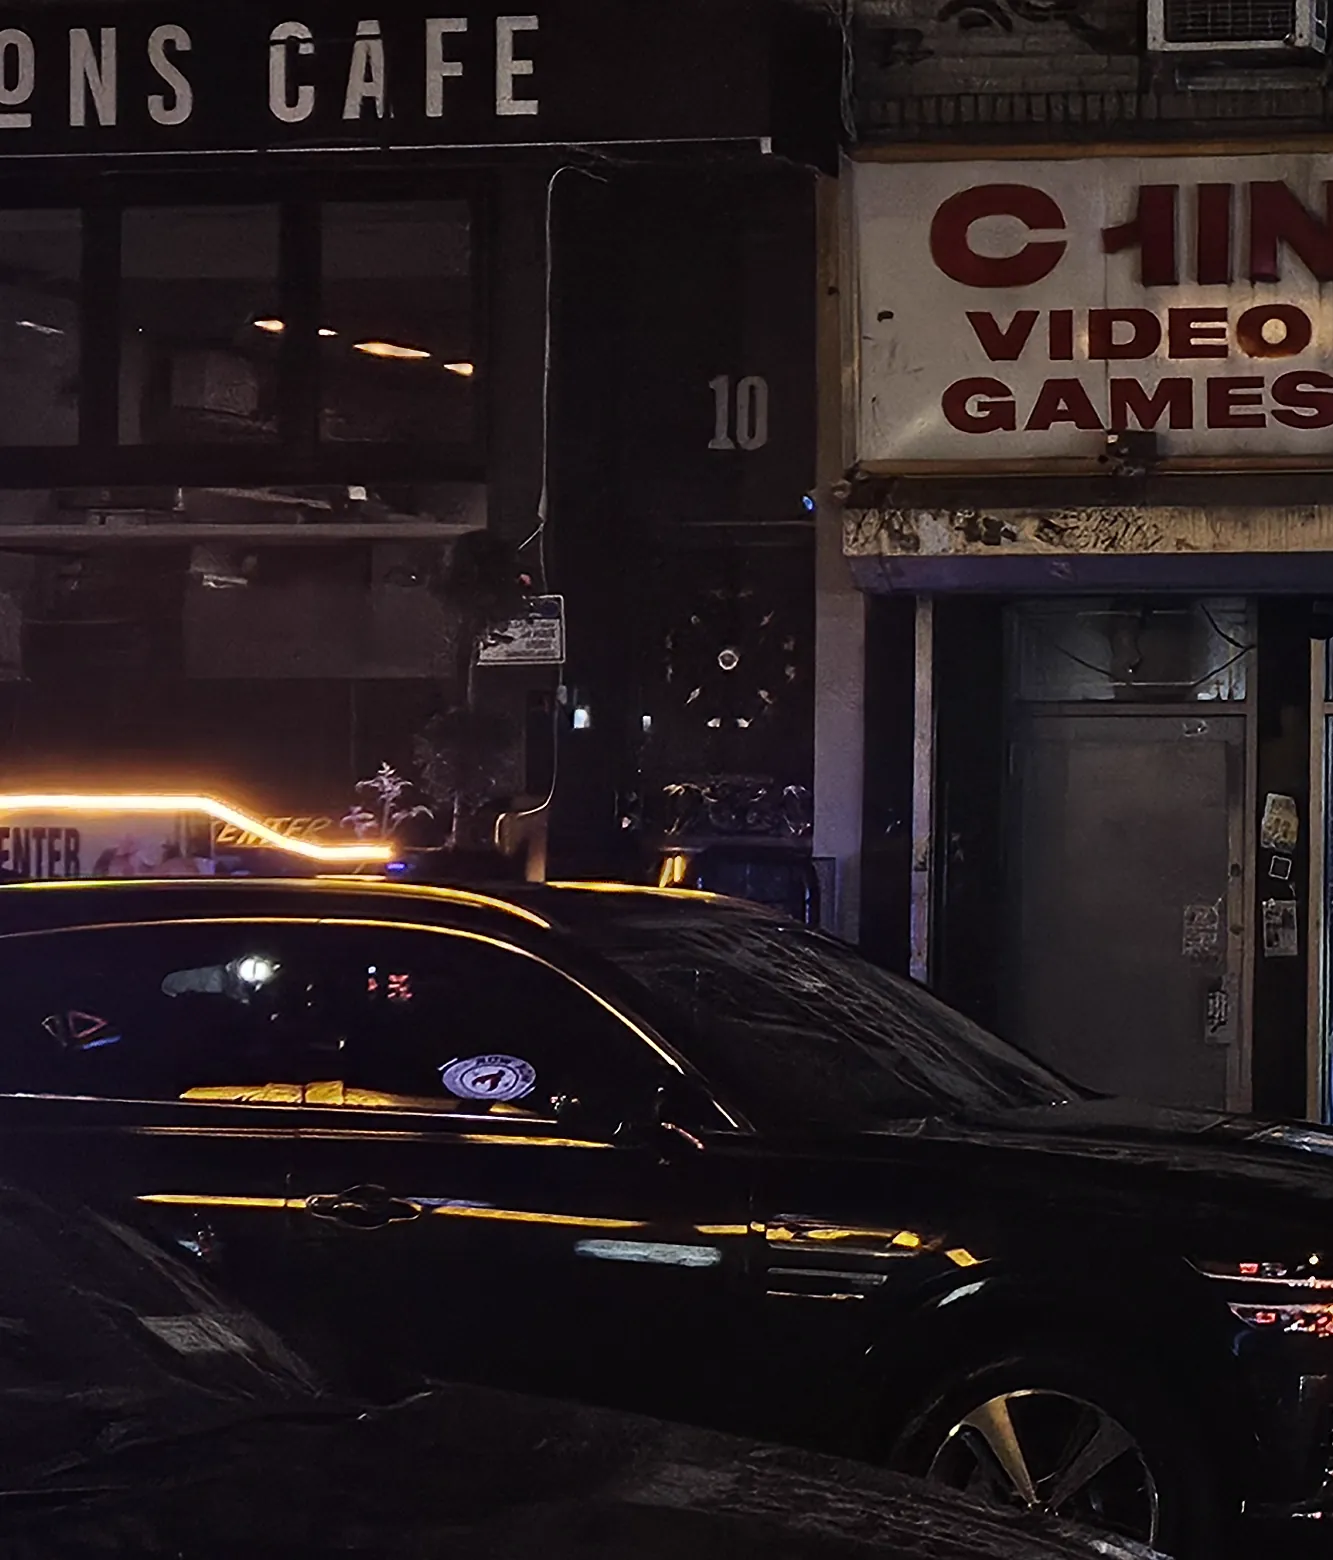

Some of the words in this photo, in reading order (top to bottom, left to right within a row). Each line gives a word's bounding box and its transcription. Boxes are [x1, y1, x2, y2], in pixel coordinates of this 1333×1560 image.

[269, 15, 539, 123] CAFE
[965, 303, 1313, 361] VIDEO
[707, 374, 769, 451] 10
